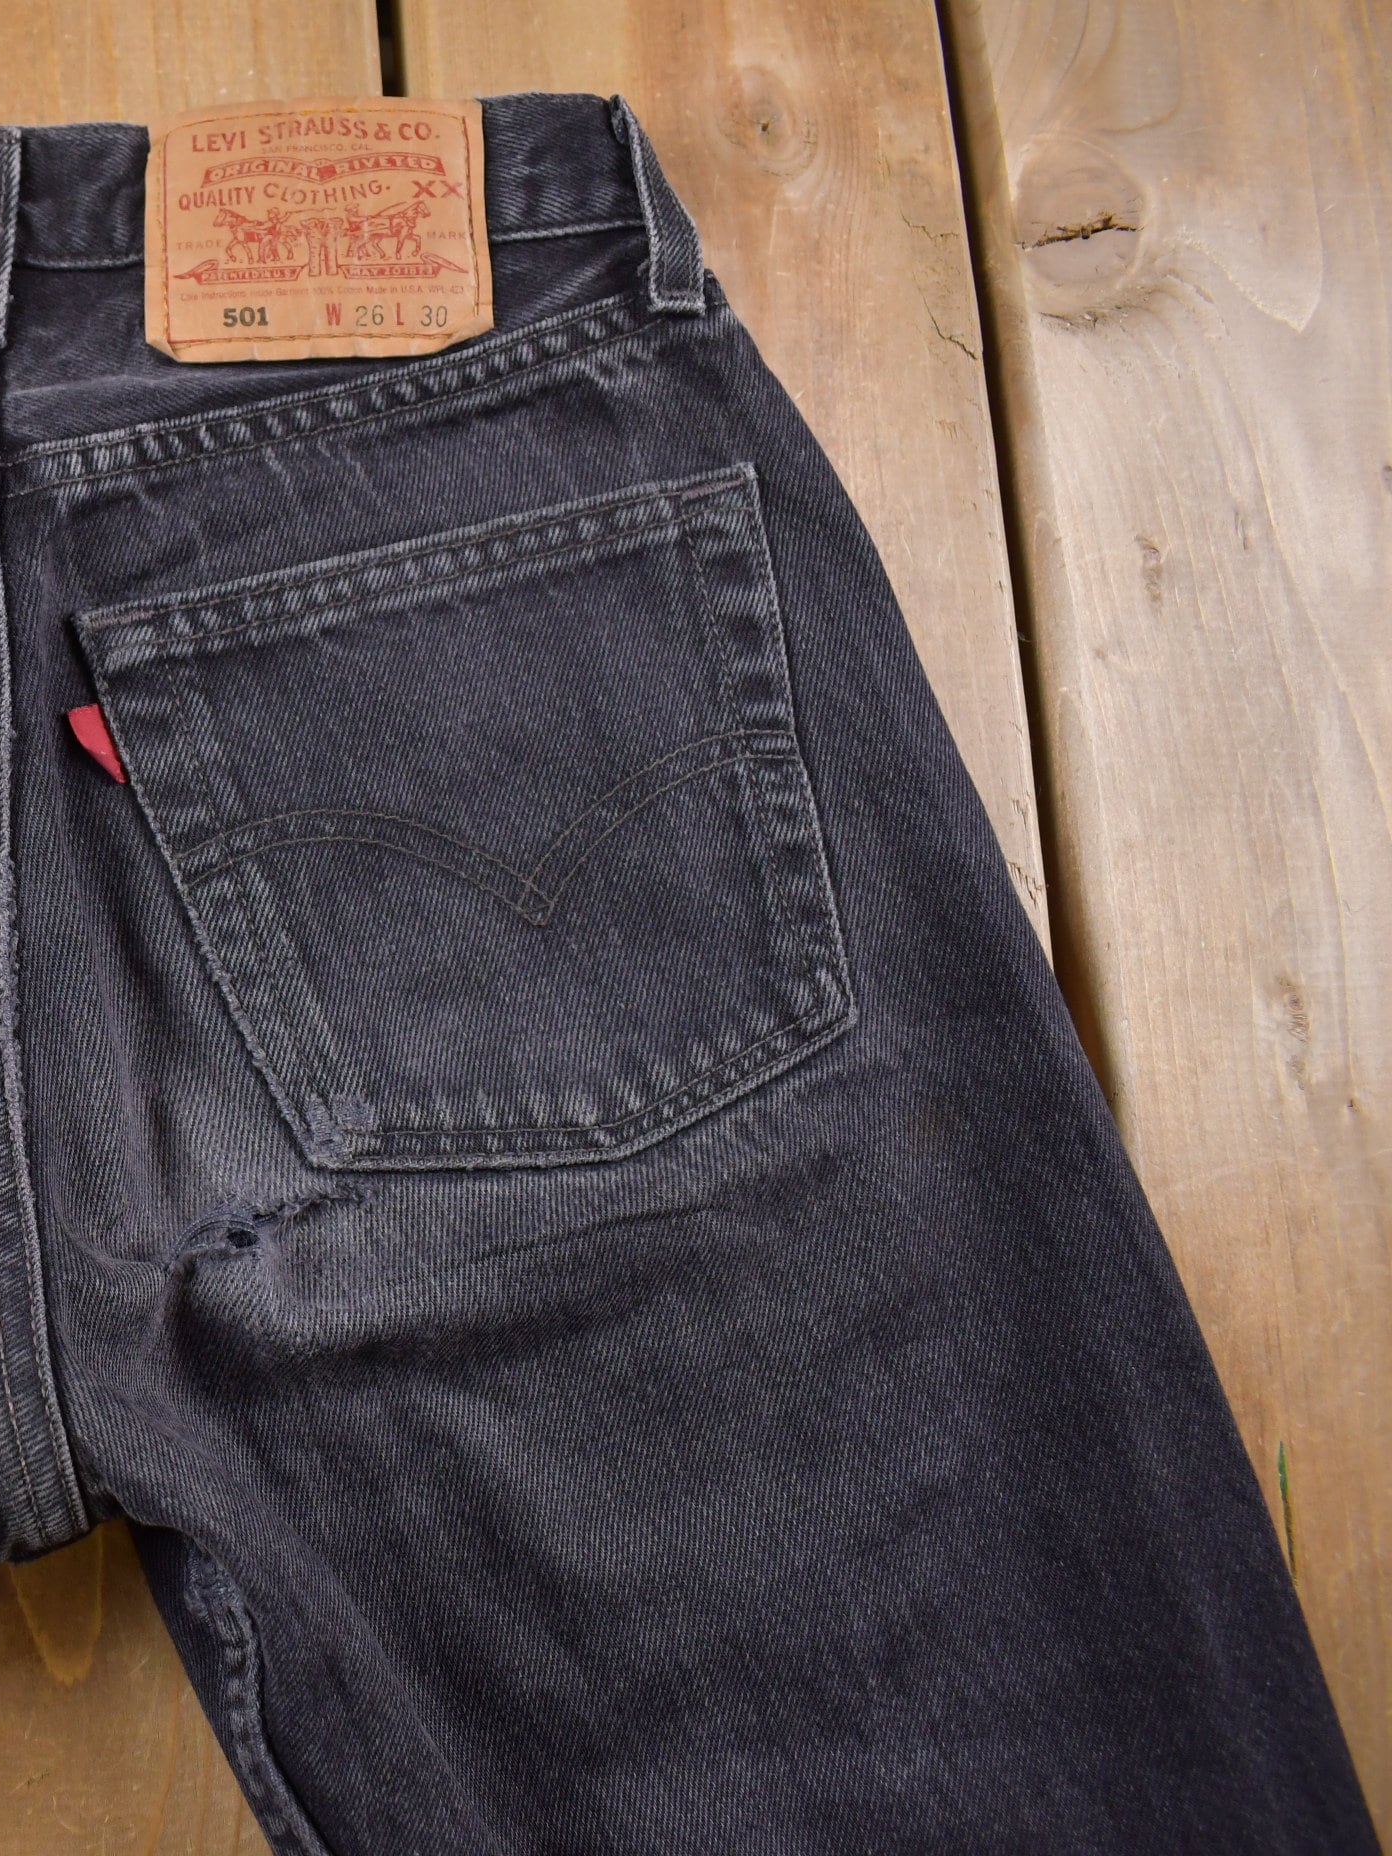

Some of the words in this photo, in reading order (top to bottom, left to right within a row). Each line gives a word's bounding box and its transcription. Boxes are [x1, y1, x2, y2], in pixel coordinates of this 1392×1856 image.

[192, 130, 246, 152] LEVI
[258, 116, 368, 145] STRAUSS
[374, 122, 391, 141] &
[398, 121, 441, 141] CO.
[262, 146, 282, 154] SAN
[208, 159, 320, 181] ORIGINAL
[335, 155, 438, 174] RIVETED
[178, 186, 255, 211] QUALITY
[263, 180, 391, 205] CLOTHING.
[412, 180, 464, 200] XX
[176, 239, 224, 251] TRADE
[426, 231, 466, 241] MARK
[223, 306, 269, 327] 501
[326, 302, 342, 326] W
[355, 304, 385, 327] 26
[396, 302, 405, 326] L
[420, 304, 448, 327] 30
